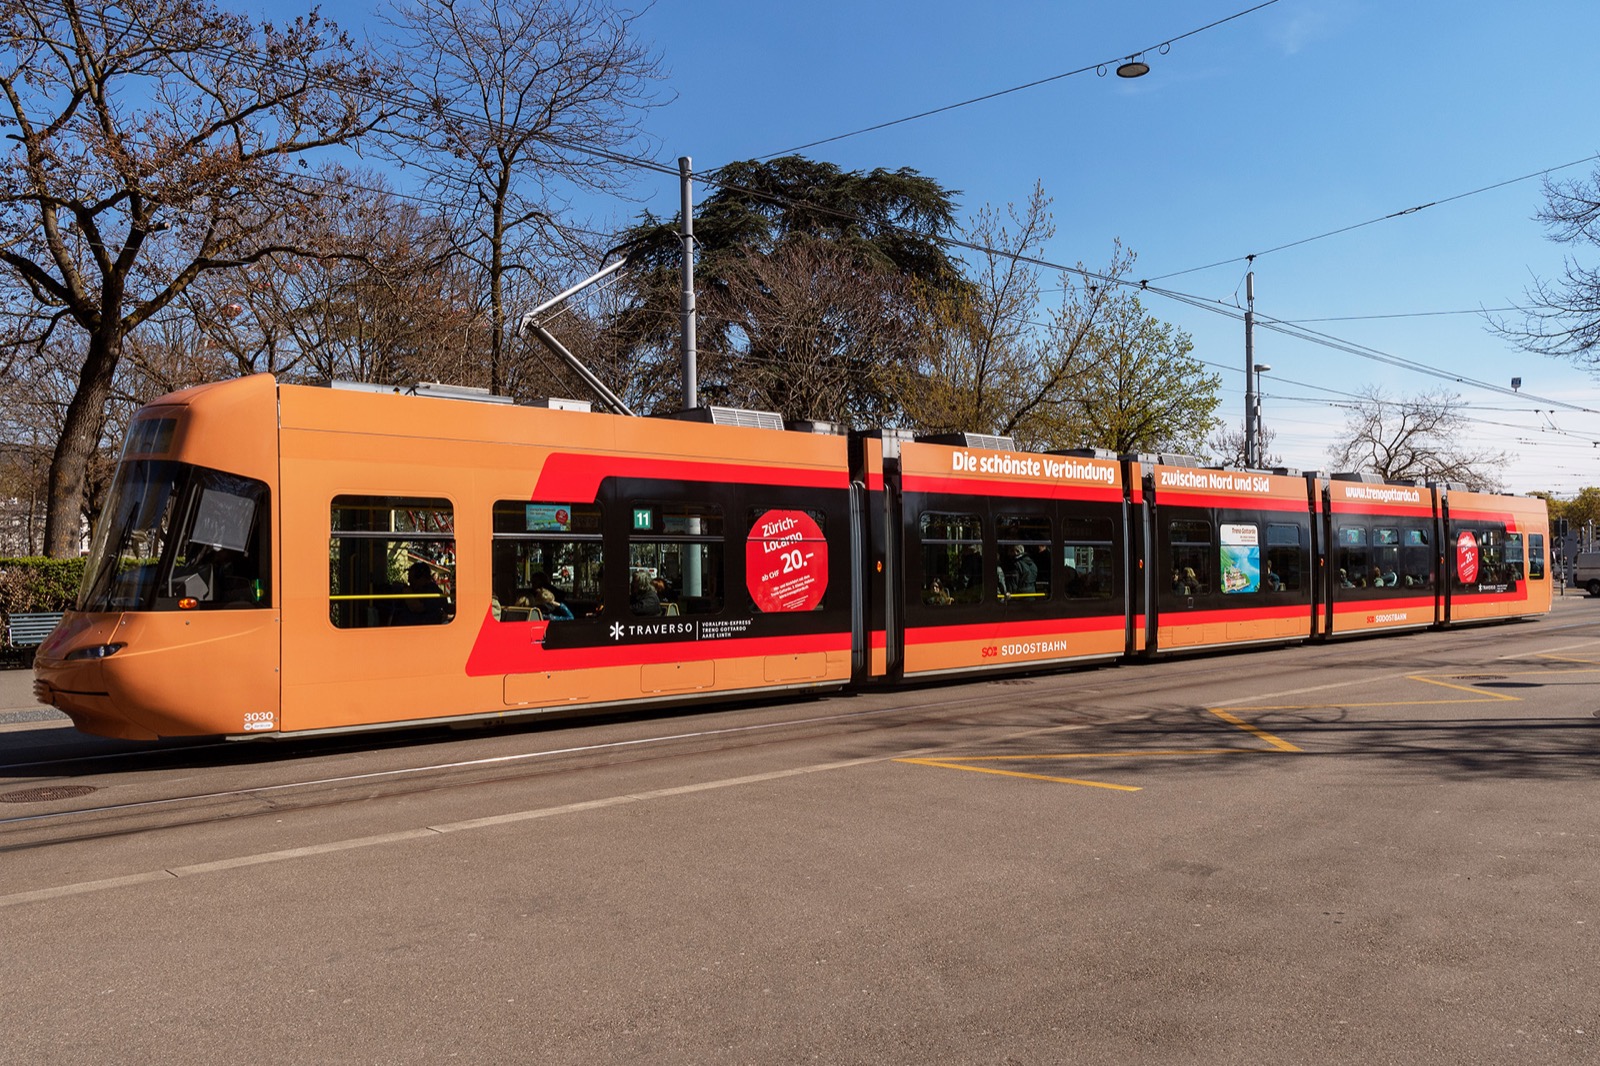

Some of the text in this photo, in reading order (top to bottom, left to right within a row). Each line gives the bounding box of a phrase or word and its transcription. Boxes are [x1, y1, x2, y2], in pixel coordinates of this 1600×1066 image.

[952, 451, 1115, 484] Die schönste Verbindung
[1161, 470, 1270, 493] zwischen Nord und Süd
[1345, 486, 1420, 503] www.trenogottardo.ch
[636, 512, 649, 526] 11
[762, 517, 799, 538] Zürich-
[763, 532, 803, 554] Locarno
[628, 623, 693, 636] TRAVERSO
[243, 711, 274, 722] 3030
